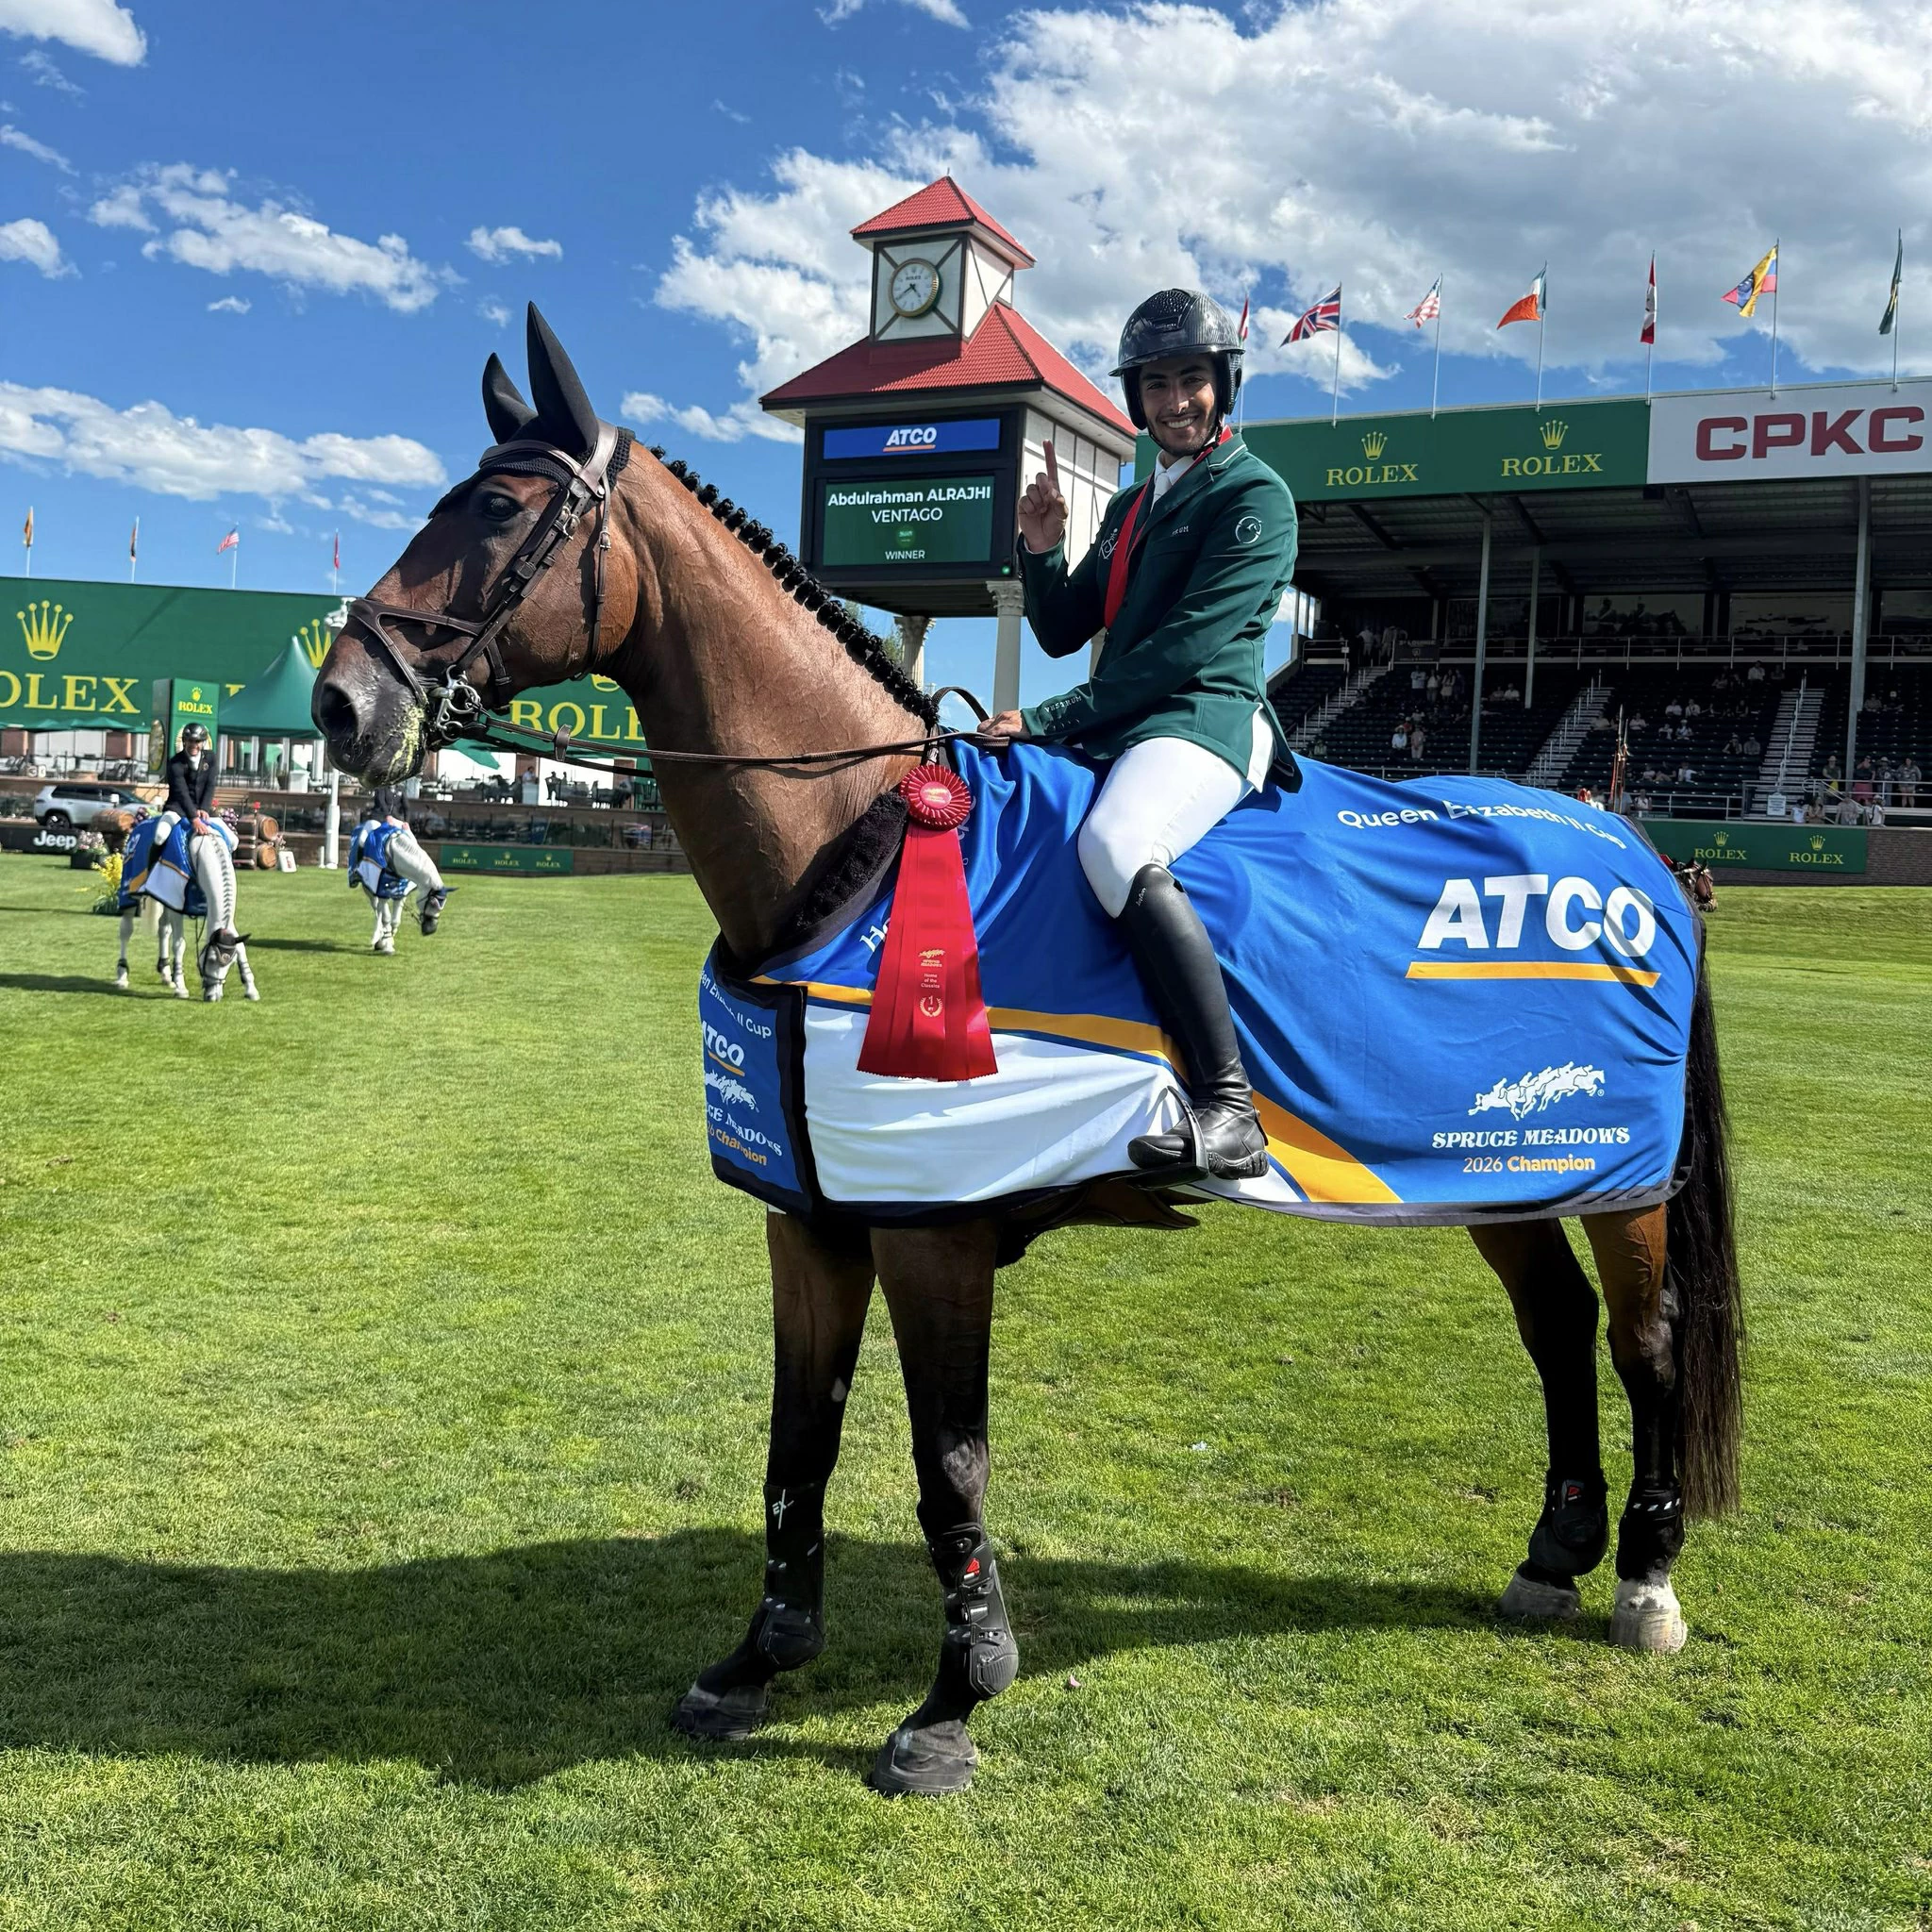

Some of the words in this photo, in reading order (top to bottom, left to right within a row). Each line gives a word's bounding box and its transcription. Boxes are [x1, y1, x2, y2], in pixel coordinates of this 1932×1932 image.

[886, 427, 937, 446] ATCO
[1695, 406, 1924, 461] CPKC
[1325, 463, 1419, 486] ROLEX
[1500, 453, 1603, 476] ROLEX
[827, 491, 924, 507] Abdulrahman
[926, 486, 991, 502] ALRAJHI
[872, 508, 942, 523] VENTAGO
[885, 550, 925, 560] WINNER
[178, 701, 213, 714] ROLEX
[1337, 808, 1440, 829] Queen
[33, 830, 77, 850] Jeep
[1694, 848, 1747, 860] ROLEX
[1789, 852, 1844, 865] ROLEX
[1417, 874, 1656, 957] ATCO
[745, 1018, 772, 1040] Cup
[1432, 1130, 1518, 1149] SPRUCE
[1521, 1127, 1630, 1146] MEADOWS
[1463, 1157, 1503, 1174] 2026
[1507, 1154, 1595, 1174] Champion
